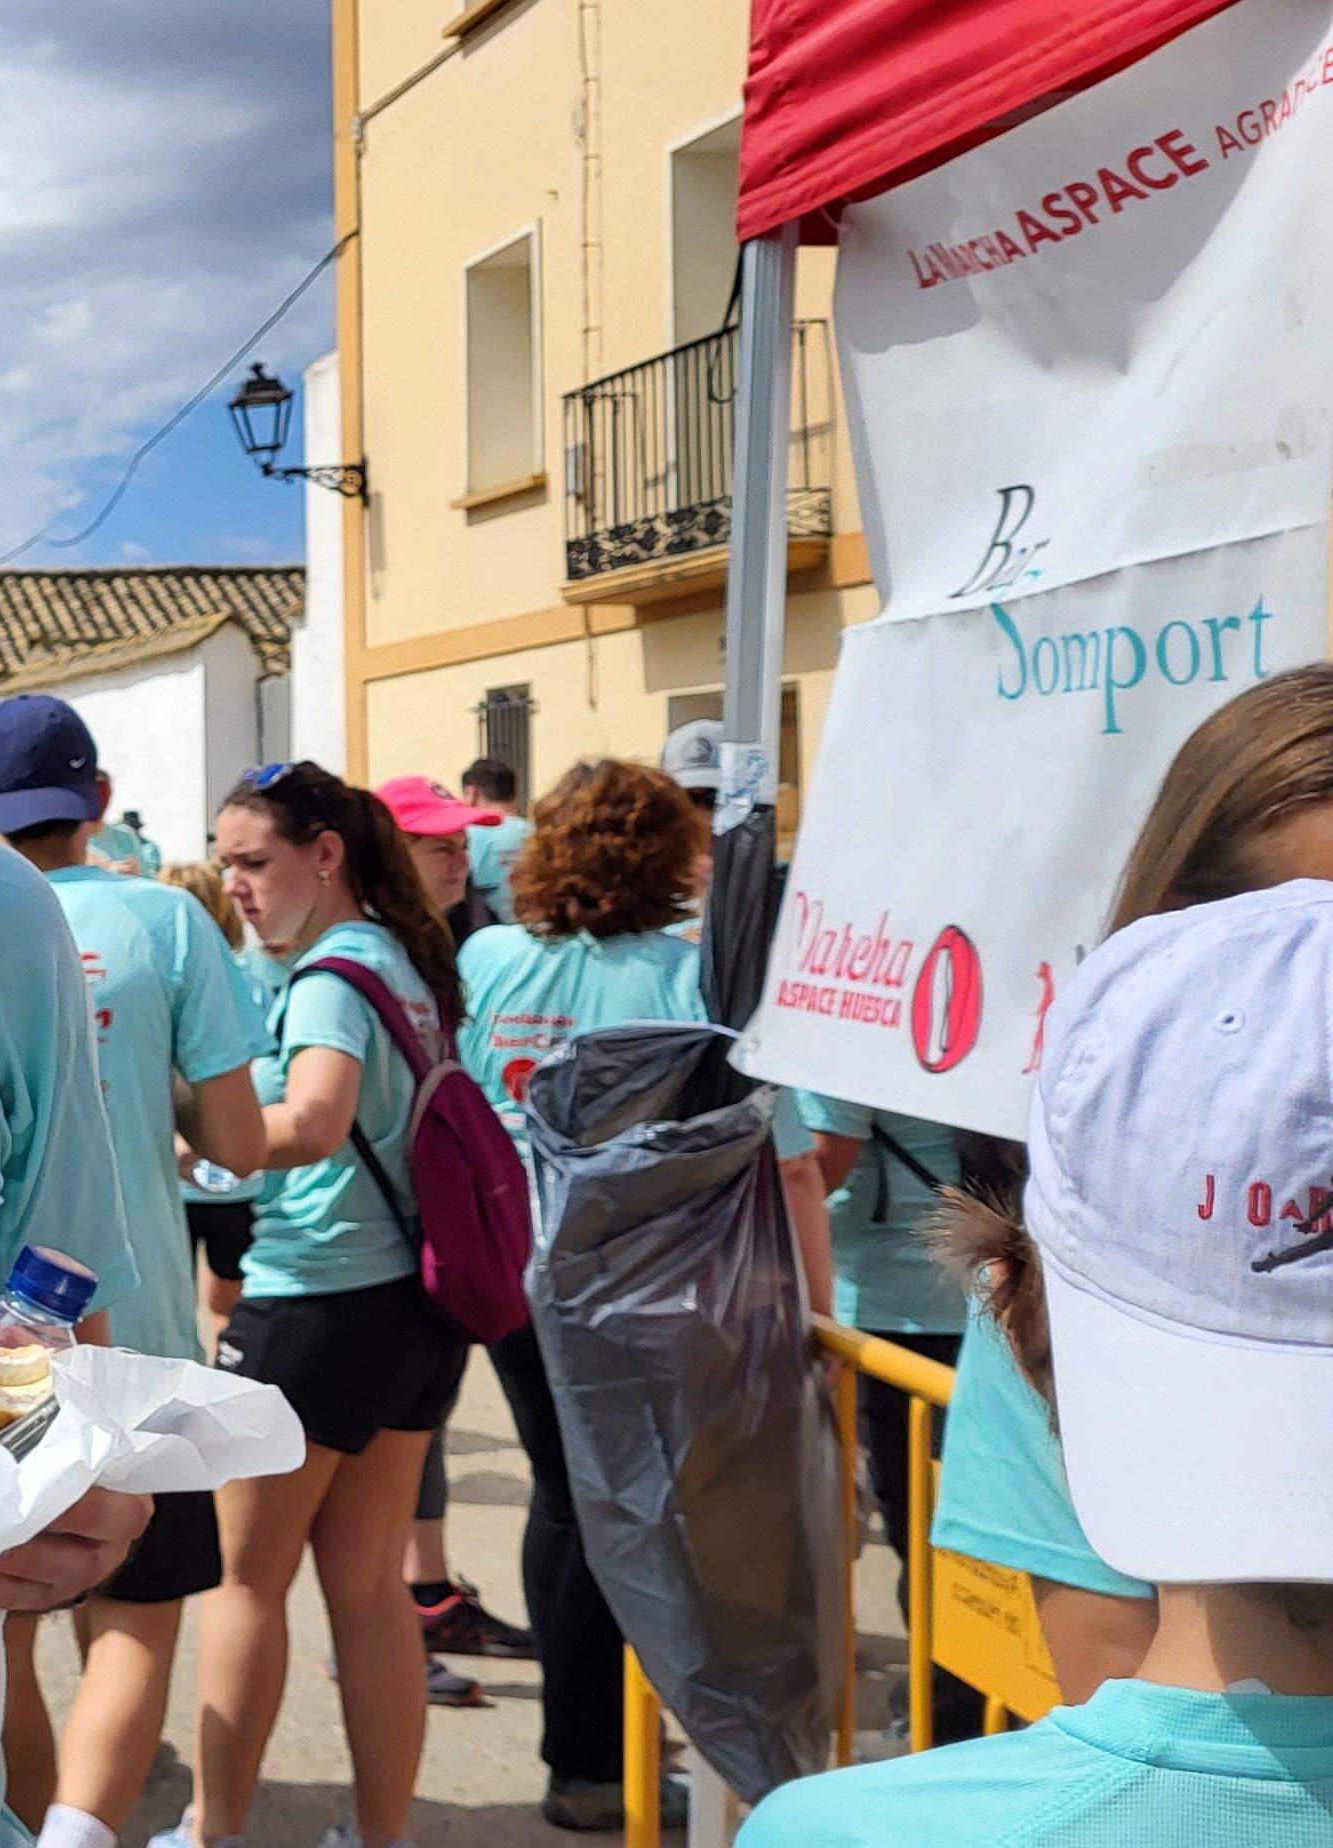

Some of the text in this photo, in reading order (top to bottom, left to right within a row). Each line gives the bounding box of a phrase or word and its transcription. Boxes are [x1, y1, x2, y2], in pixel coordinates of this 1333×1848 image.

[1015, 128, 1210, 254] ASPACE
[777, 978, 903, 1031] ASPACE HUESCA
